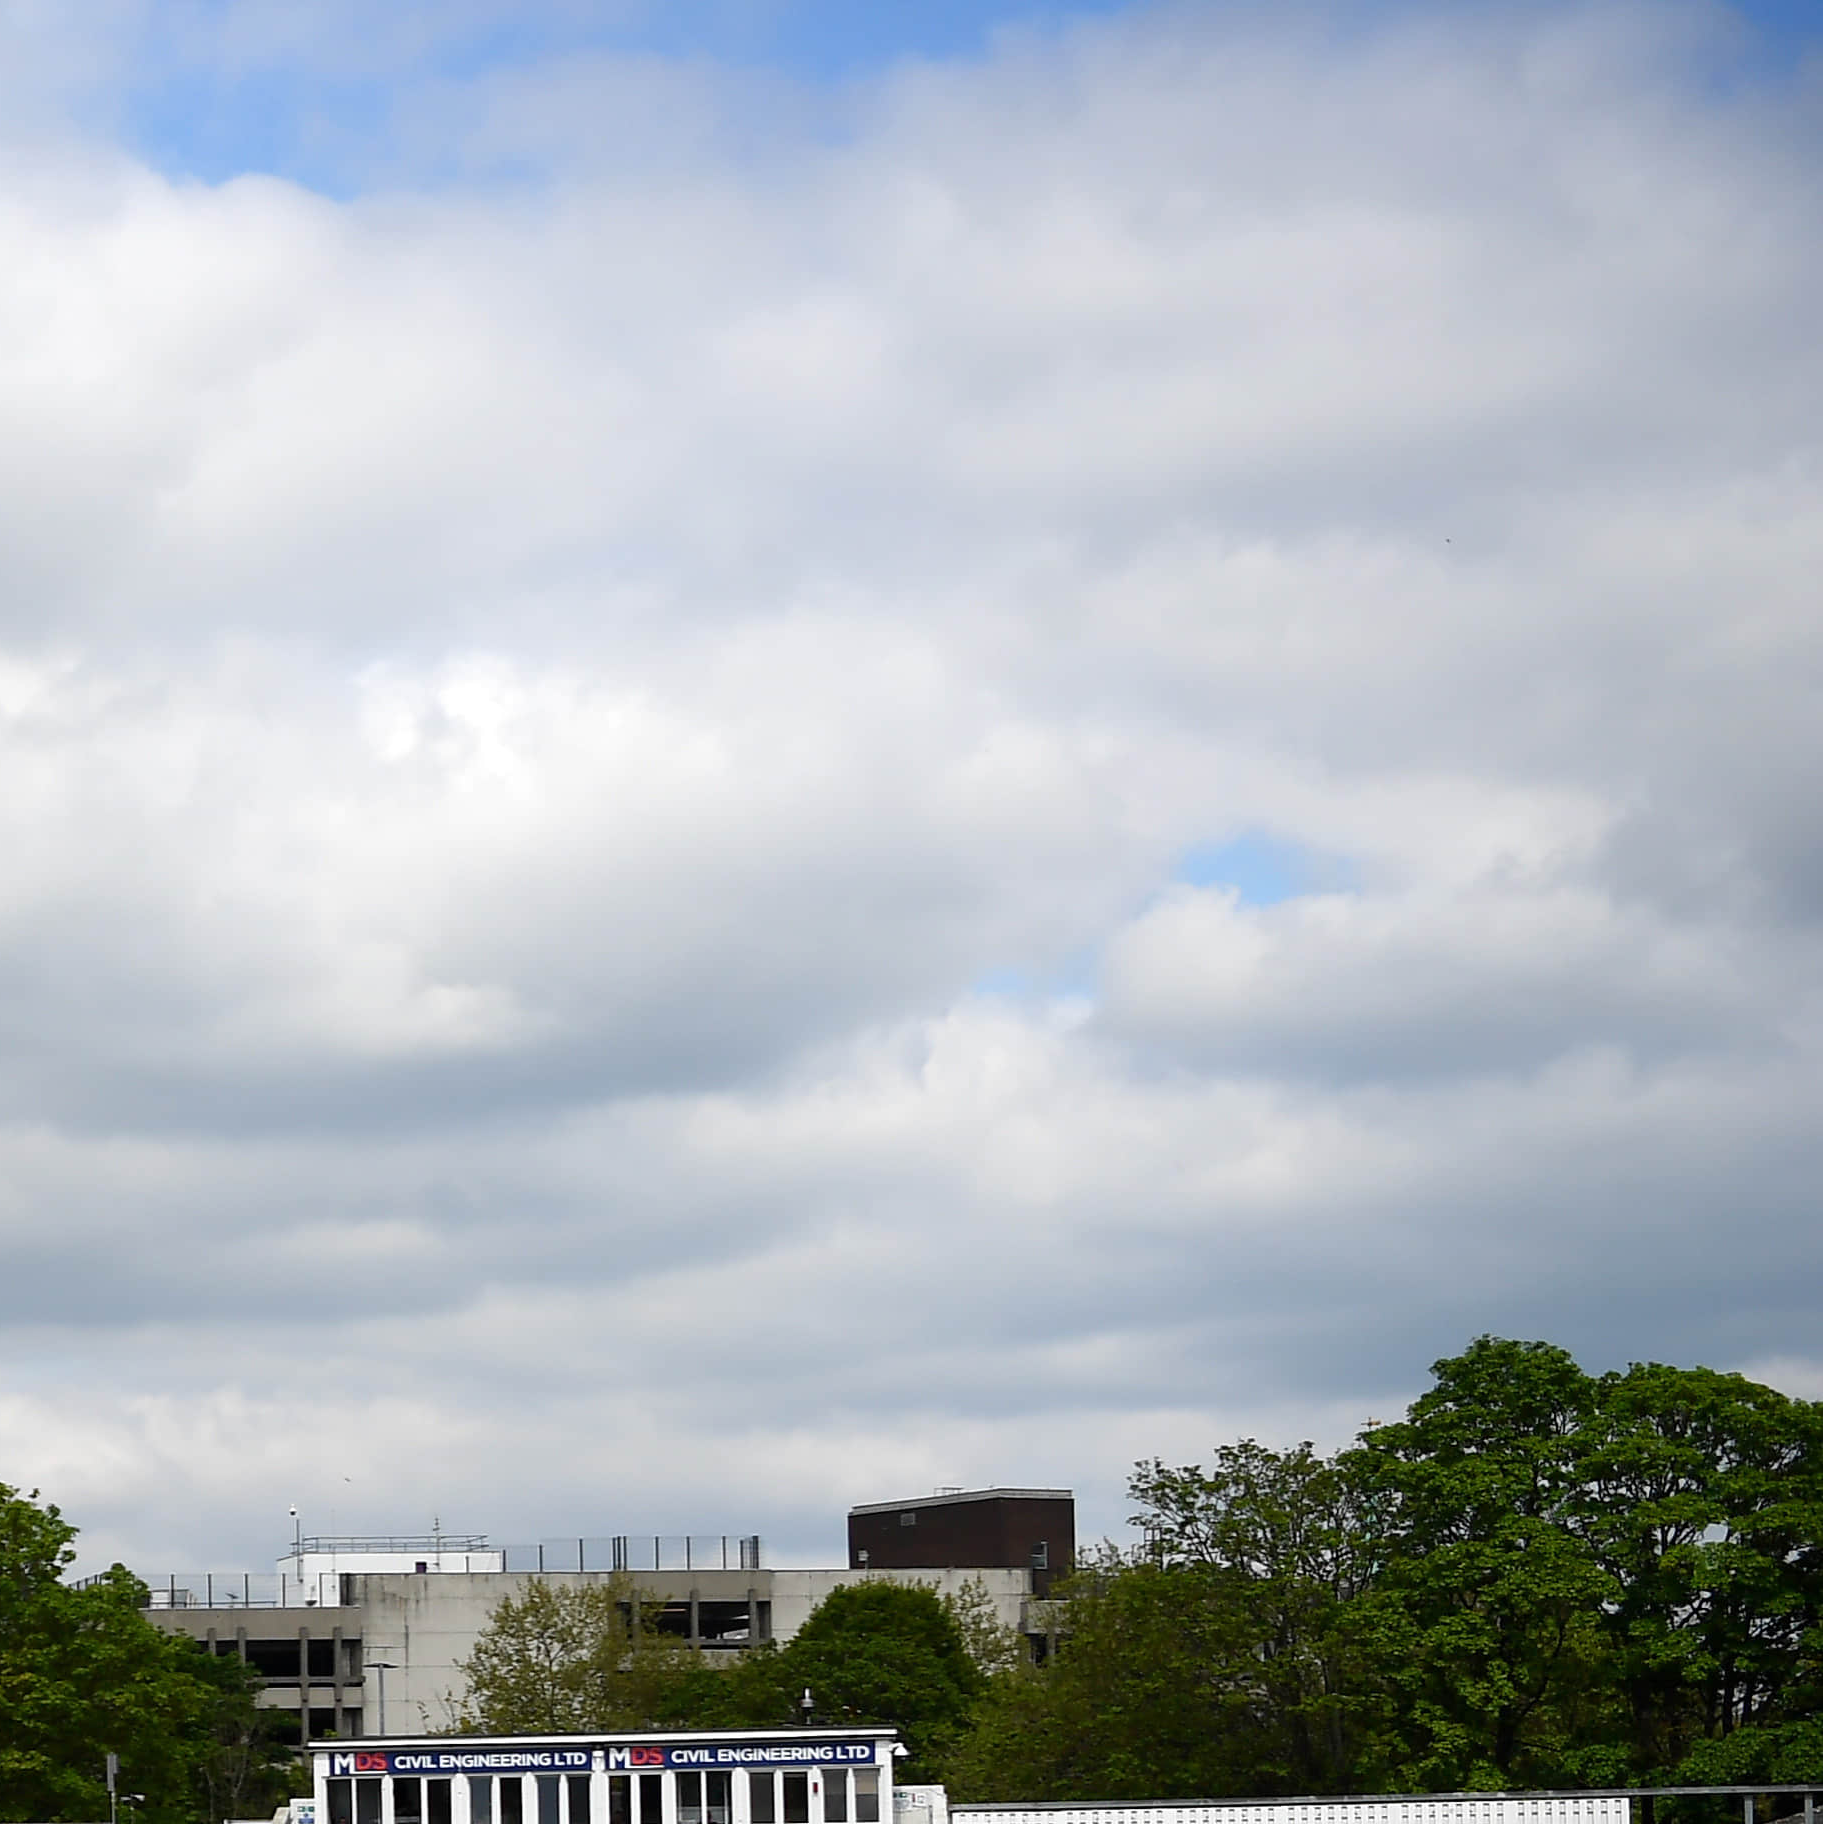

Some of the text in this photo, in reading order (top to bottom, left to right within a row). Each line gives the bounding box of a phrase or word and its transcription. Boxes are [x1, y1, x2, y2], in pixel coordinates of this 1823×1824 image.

[334, 1752, 587, 1775] MDS CIVIL ENGINEERING LTD
[609, 1746, 870, 1769] MDS CIVIL ENGINEERING LTD
